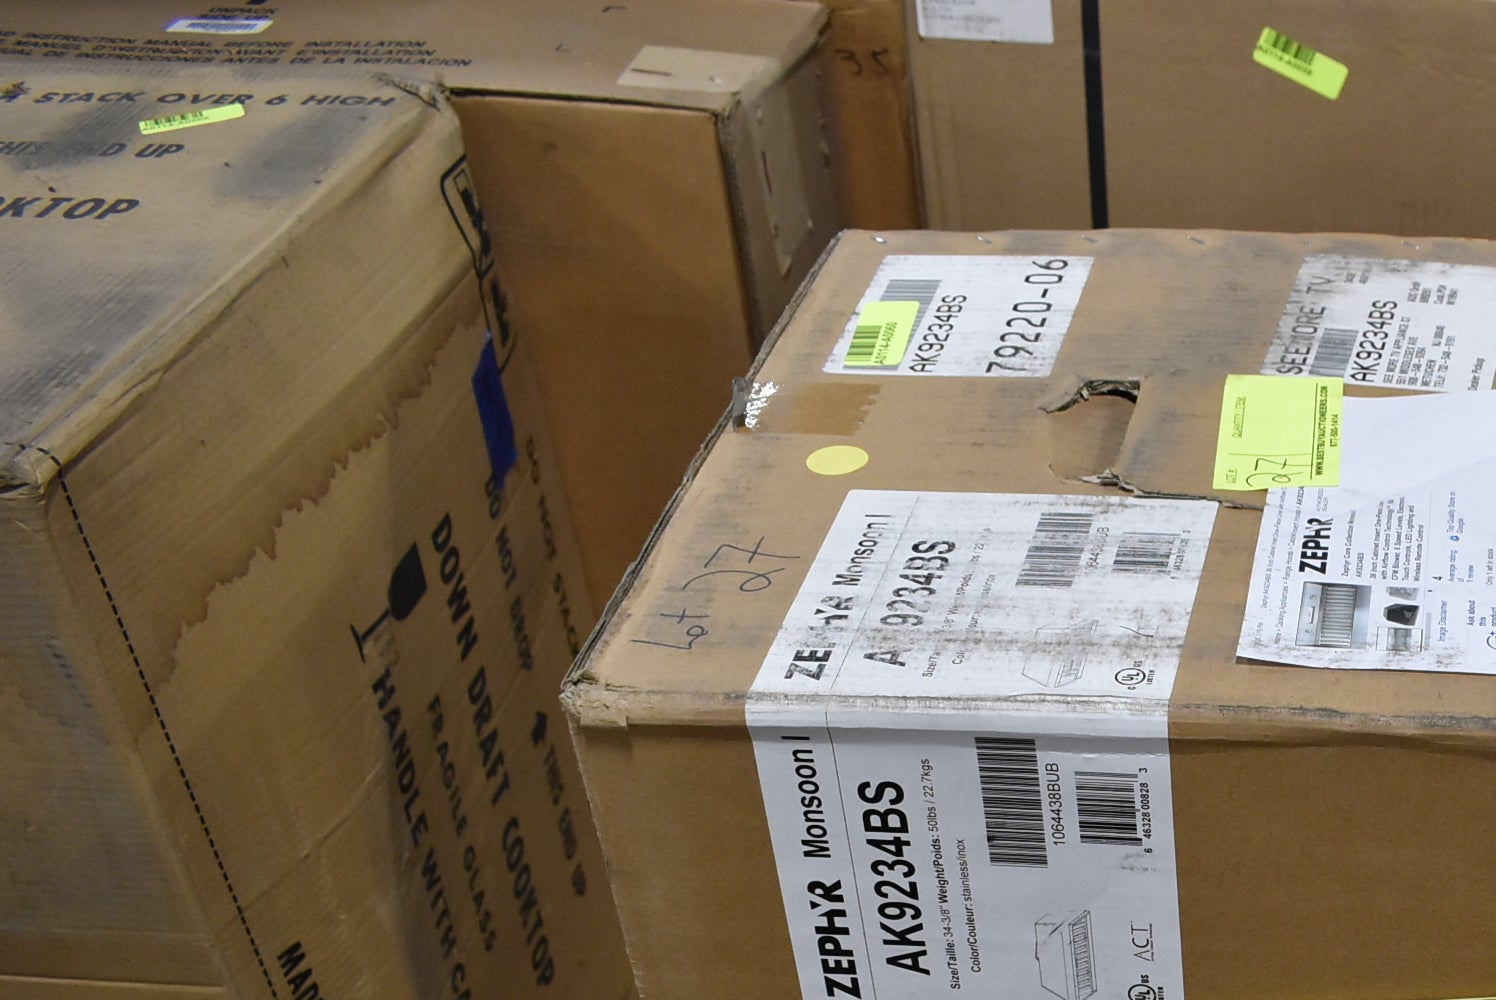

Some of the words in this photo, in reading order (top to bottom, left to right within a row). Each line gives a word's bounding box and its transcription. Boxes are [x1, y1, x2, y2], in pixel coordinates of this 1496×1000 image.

[34, 91, 147, 103] STACK
[157, 93, 254, 105] OVER
[266, 94, 289, 106] 6
[300, 94, 396, 107] HIGH
[135, 143, 187, 158] UP
[908, 294, 968, 374] AK9234BS
[985, 259, 1069, 374] 79220-06
[1346, 298, 1400, 383] AK9234BS
[829, 521, 890, 586] Monsoon
[1340, 559, 1352, 577] Zephyr
[857, 538, 960, 667] A9234BS
[432, 513, 478, 662] DOWN
[468, 666, 510, 806] DRAFT
[502, 816, 554, 987] COOKTOP
[917, 757, 936, 797] 22.7kgs
[372, 668, 429, 848] HANDLE
[422, 847, 456, 960] WITH
[792, 748, 832, 858] Monsoon
[924, 805, 940, 832] 50lbs
[1044, 761, 1067, 846] 1064438BUB
[1137, 781, 1151, 810] 00828
[1139, 810, 1153, 839] 46328
[857, 780, 931, 976] AK9234BS
[928, 833, 951, 904] Weight/Poids:
[953, 838, 973, 901] stainless/inox
[807, 879, 862, 1000] ZEPHYR
[943, 938, 962, 990] Size/Taille:
[961, 902, 982, 973] Color/Couleur:
